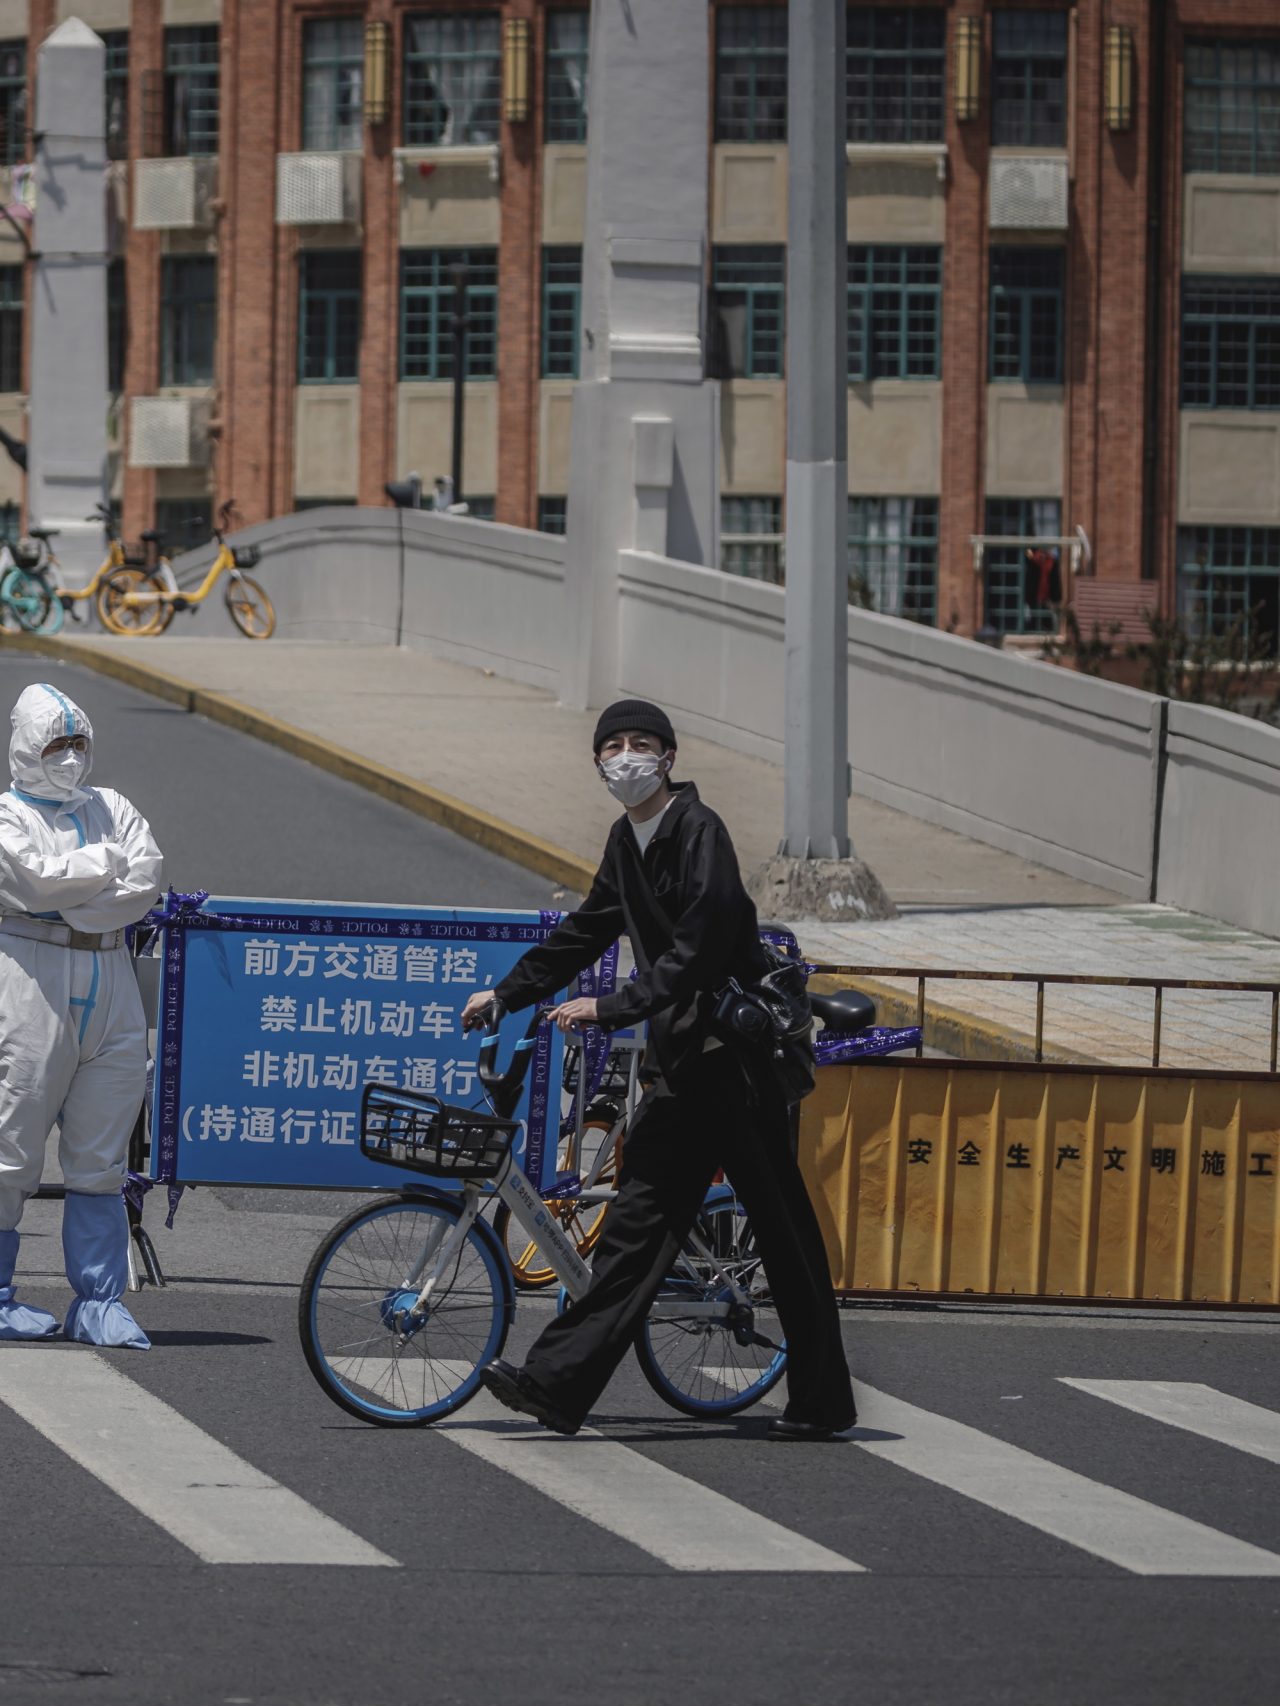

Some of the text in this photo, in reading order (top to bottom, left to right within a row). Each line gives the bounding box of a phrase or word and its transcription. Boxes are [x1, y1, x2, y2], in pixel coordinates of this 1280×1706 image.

[252, 918, 299, 931] POLICE
[342, 921, 388, 934] POLICE
[431, 924, 476, 936] POLICE
[519, 927, 554, 939] OLICE
[244, 938, 494, 986] 前方交通管控，
[166, 982, 179, 1031] POLICE
[242, 1049, 478, 1096] 非机动车通行
[535, 1035, 549, 1084] POLICE
[162, 1074, 176, 1125] POLICE
[528, 1126, 543, 1175] POLICE
[907, 1137, 1274, 1177] 安全生产文明施工
